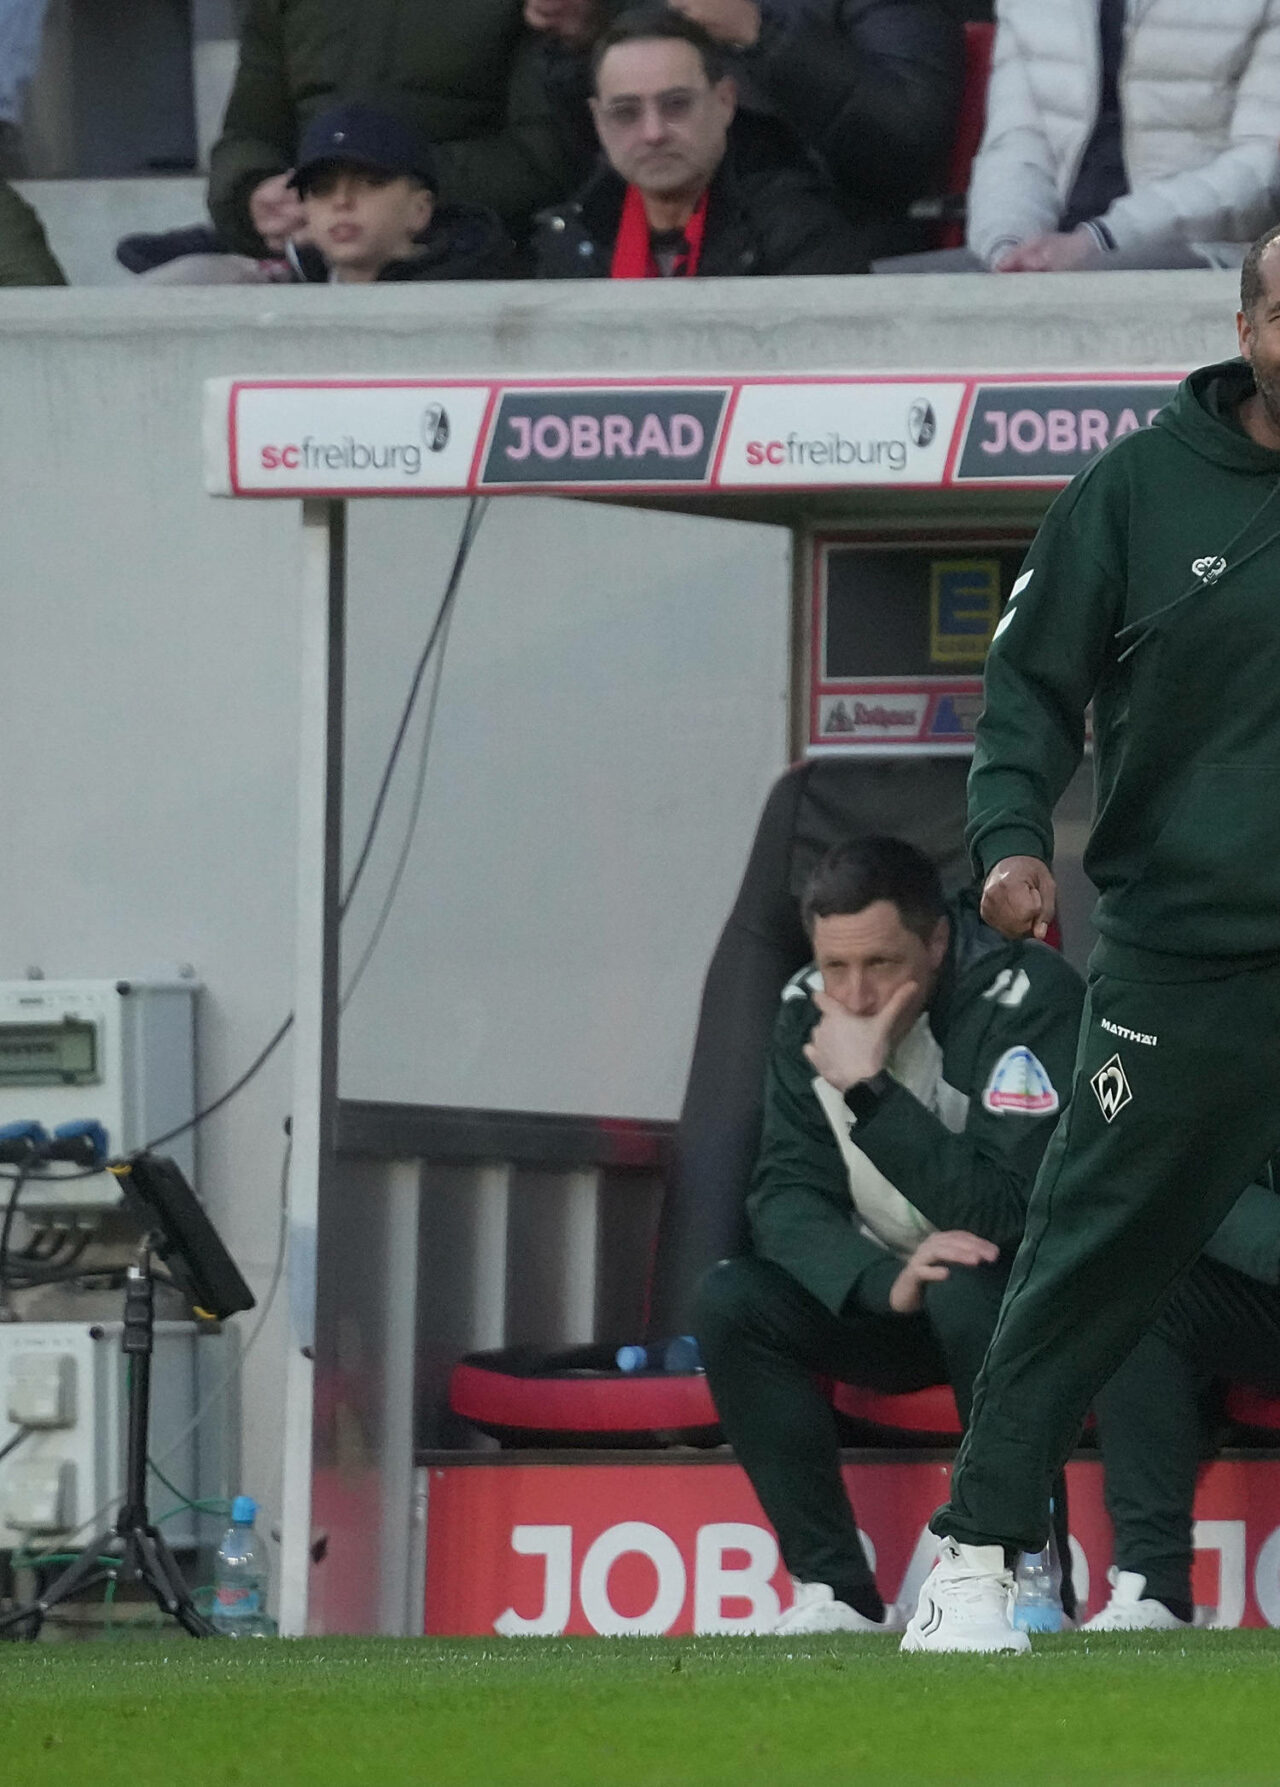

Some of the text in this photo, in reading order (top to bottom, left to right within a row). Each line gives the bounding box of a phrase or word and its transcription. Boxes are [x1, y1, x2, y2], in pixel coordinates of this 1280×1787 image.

[505, 413, 703, 461] JOBRAD
[746, 429, 907, 471] scfreiburg
[983, 408, 1162, 454] JOBRA
[261, 435, 421, 475] scfreiburg
[1101, 1018, 1158, 1046] MATTHÄI
